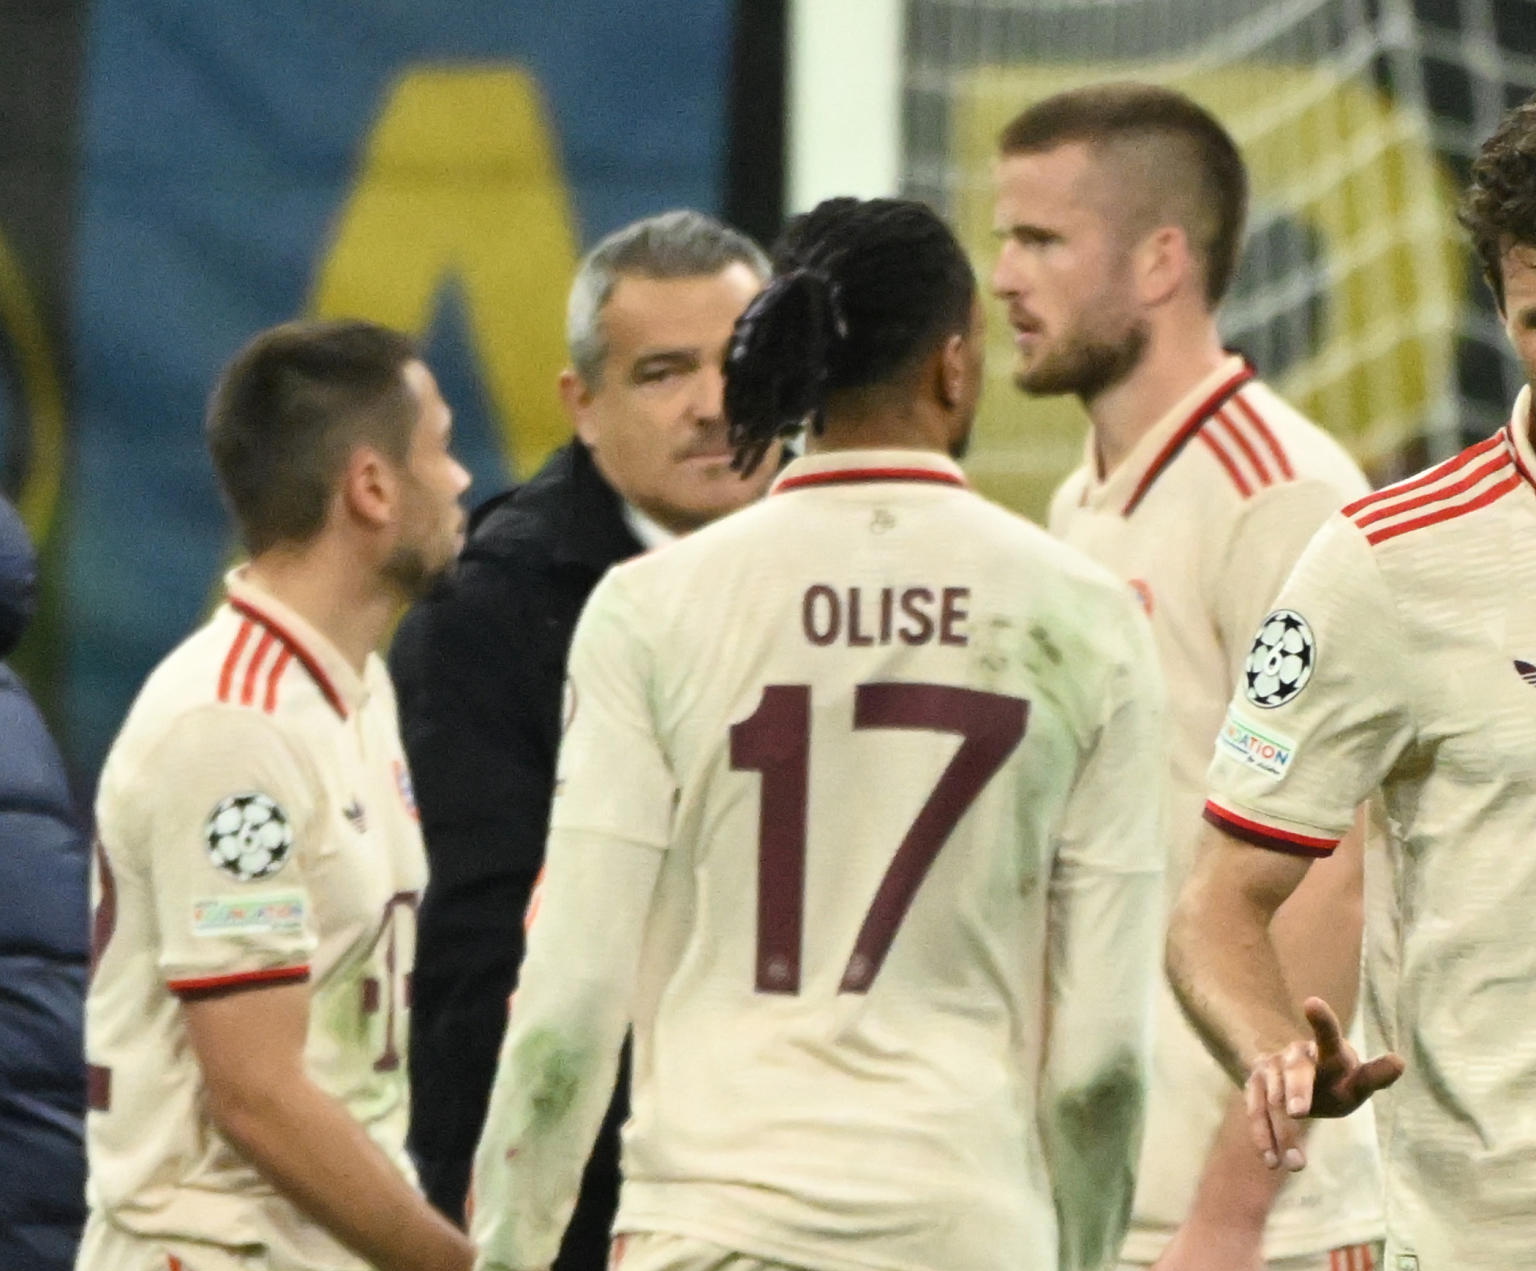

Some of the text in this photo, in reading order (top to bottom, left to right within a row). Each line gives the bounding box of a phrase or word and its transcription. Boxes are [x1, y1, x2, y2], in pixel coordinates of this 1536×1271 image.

[802, 584, 970, 647] OLISE
[1263, 641, 1285, 676] 6
[729, 682, 1030, 996] 17
